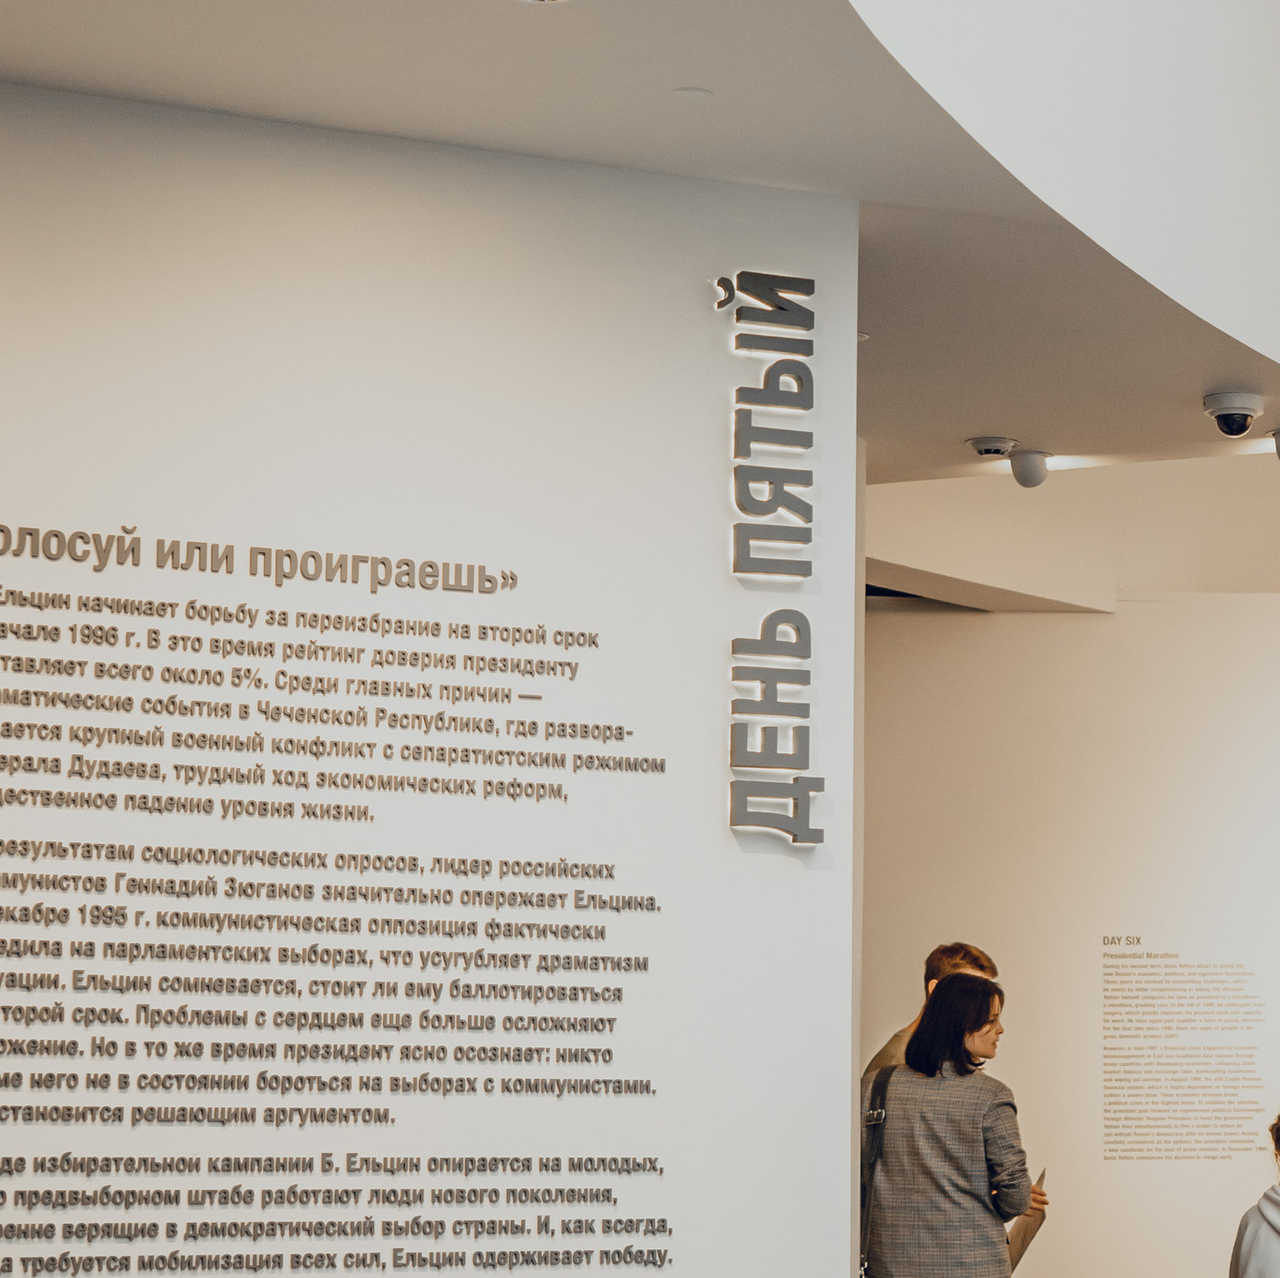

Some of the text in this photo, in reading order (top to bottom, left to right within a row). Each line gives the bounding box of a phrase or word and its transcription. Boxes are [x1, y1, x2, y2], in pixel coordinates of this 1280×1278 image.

[156, 539, 234, 575] или
[249, 547, 518, 595] проиграешь»
[716, 270, 825, 844] ДЕНЬ ПЯТЫЙ
[77, 595, 599, 651] начинает борьбу за переизбрание на второй срок
[68, 624, 579, 682] 1996 г. В это время рейтинг доверия президенту
[140, 694, 633, 745] события в Чеченской Республике, где развора-
[69, 725, 666, 774] крупный военный конфликт с сепаратистским режимом
[67, 754, 568, 804] Дудаева, трудный ход экономических реформ,
[141, 846, 615, 882] социологических опросов, лидер российских
[114, 872, 661, 914] Геннадий Зюганов значительно опережает Ельцина.
[78, 904, 606, 943] 1995 г. коммунистическая оппозиция фактически
[1103, 936, 1141, 946] DAY SIX
[70, 941, 649, 976] на парламентских выборах, что усугубляет драматизм
[72, 970, 623, 1007] Ельцин сомневается, стоит ли ему баллотироваться
[71, 1004, 617, 1035] срок. Проблемы с сердцем еще больше осложняют
